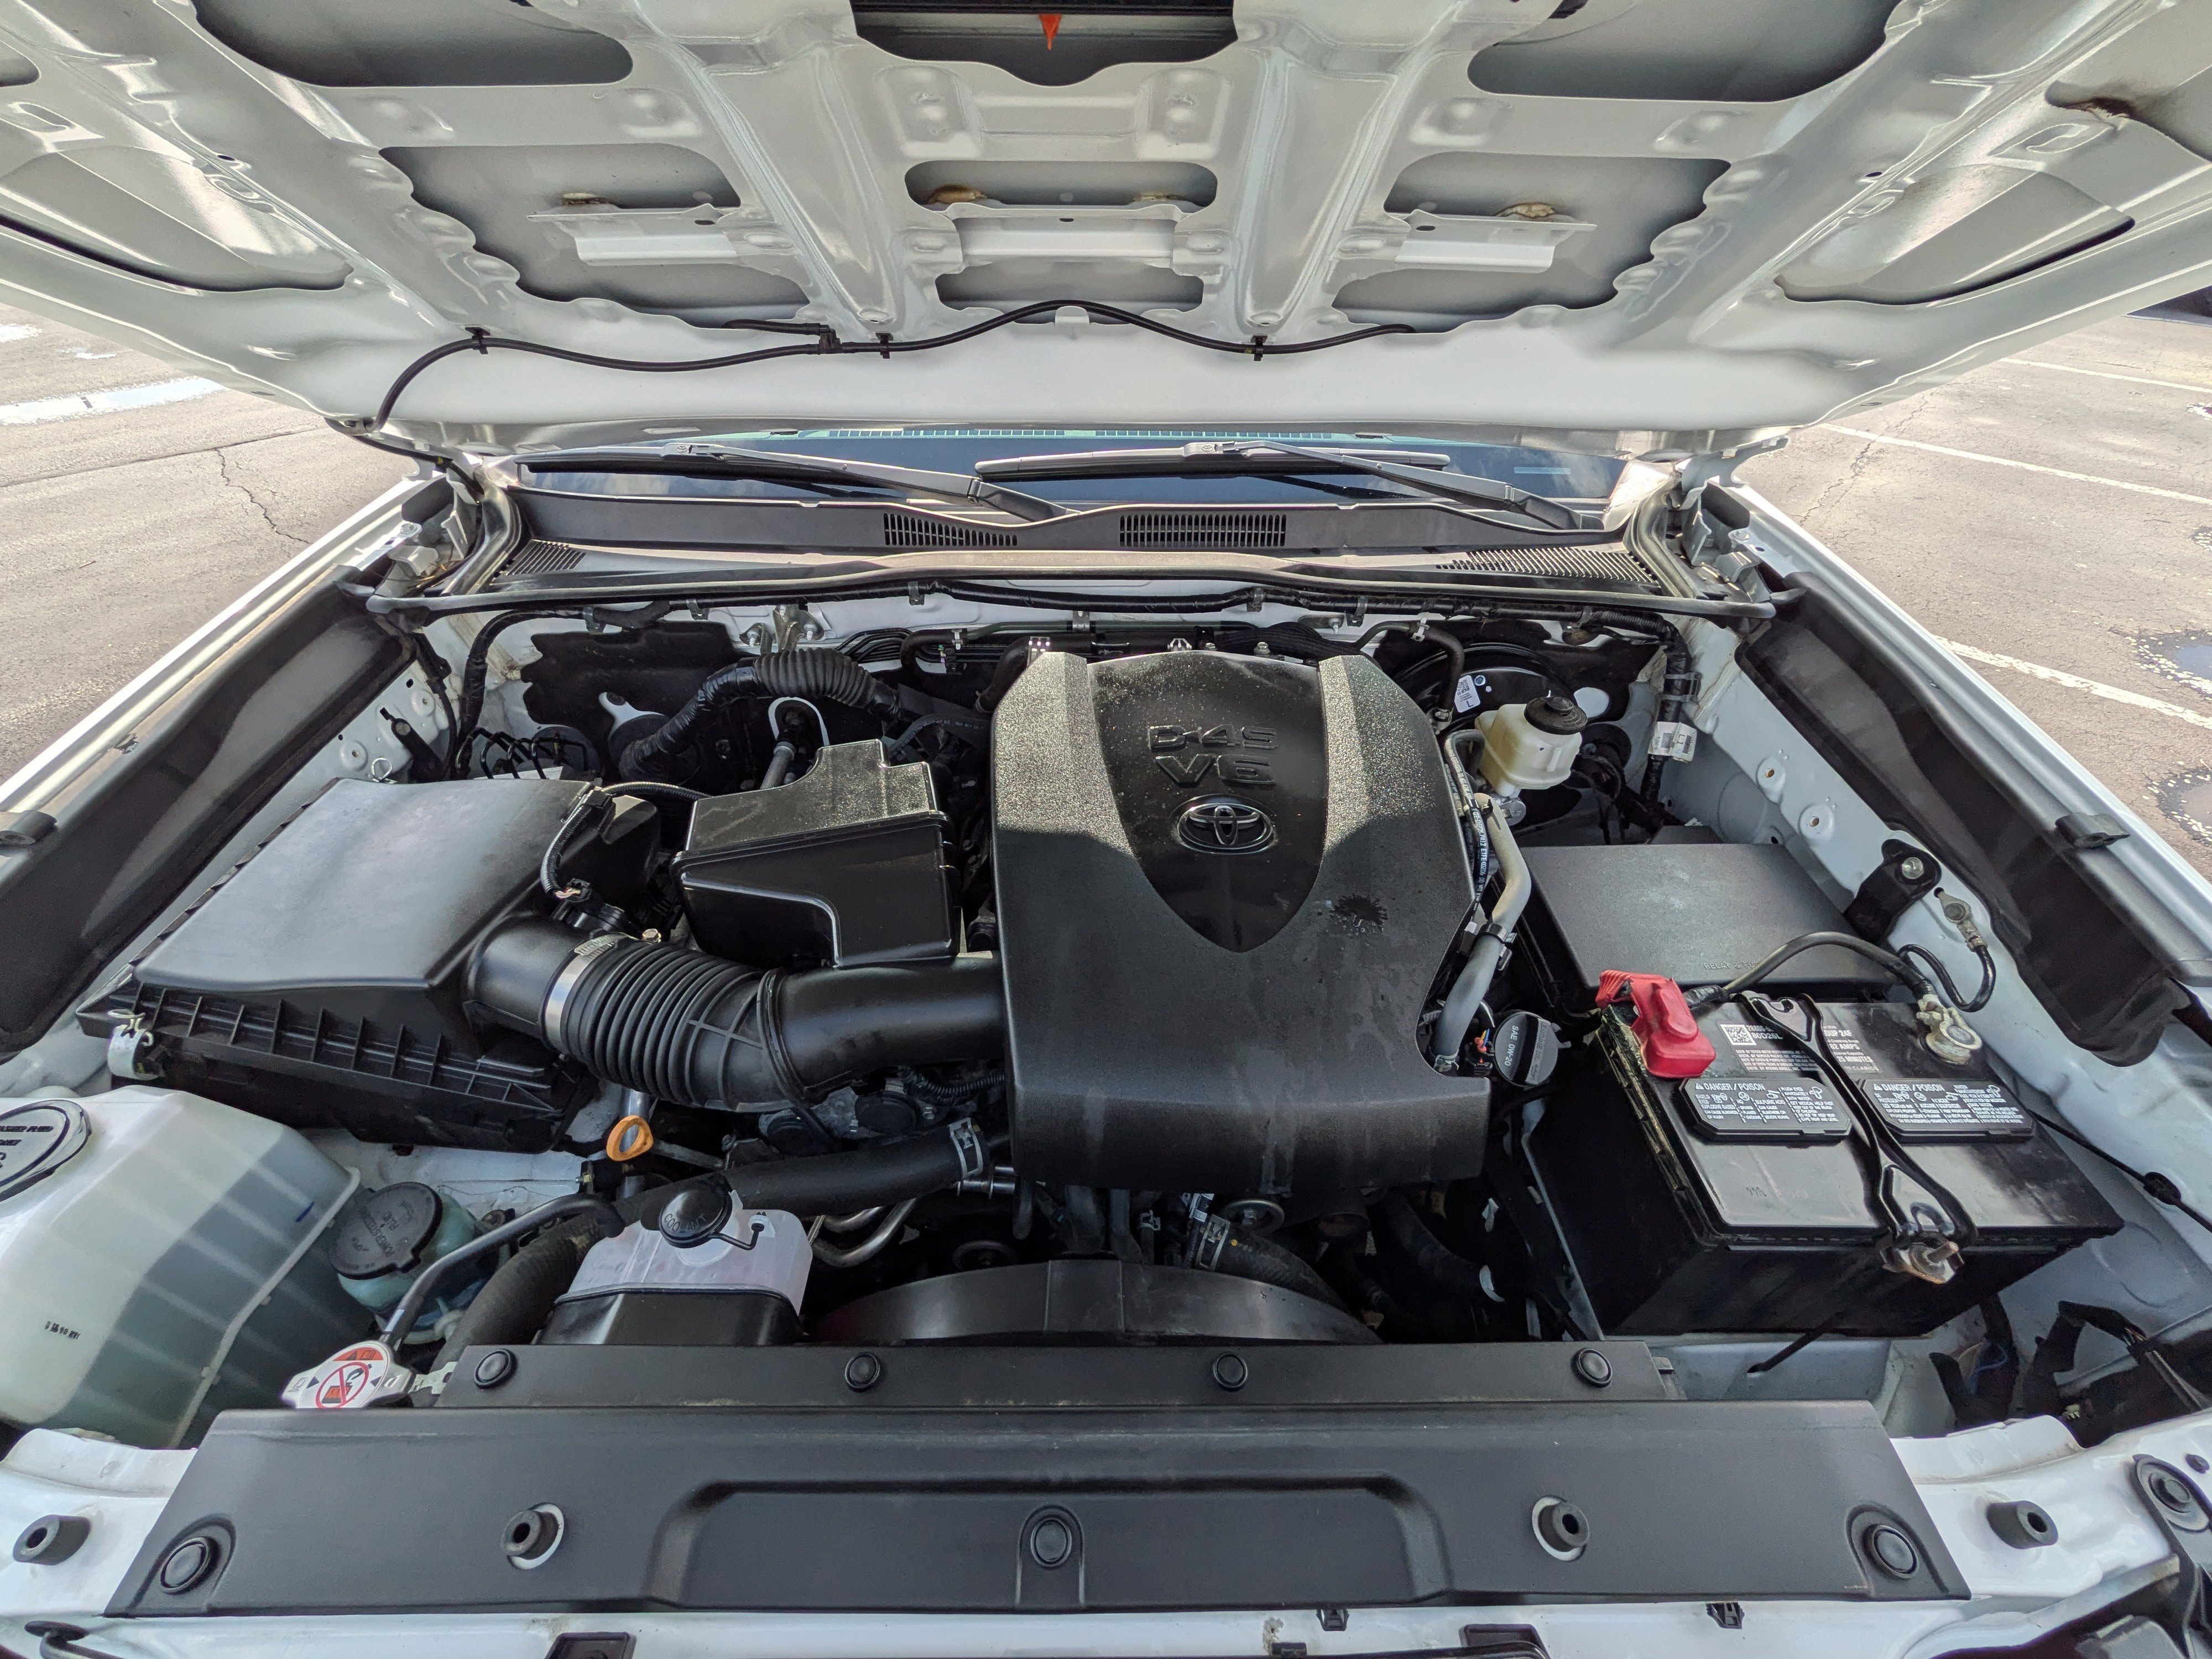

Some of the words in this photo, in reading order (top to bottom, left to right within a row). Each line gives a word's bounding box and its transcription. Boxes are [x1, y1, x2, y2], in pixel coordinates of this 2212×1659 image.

[1154, 754, 1276, 787] V6
[1510, 1025, 1519, 1041] SAE
[1504, 1044, 1515, 1066] 0W-20
